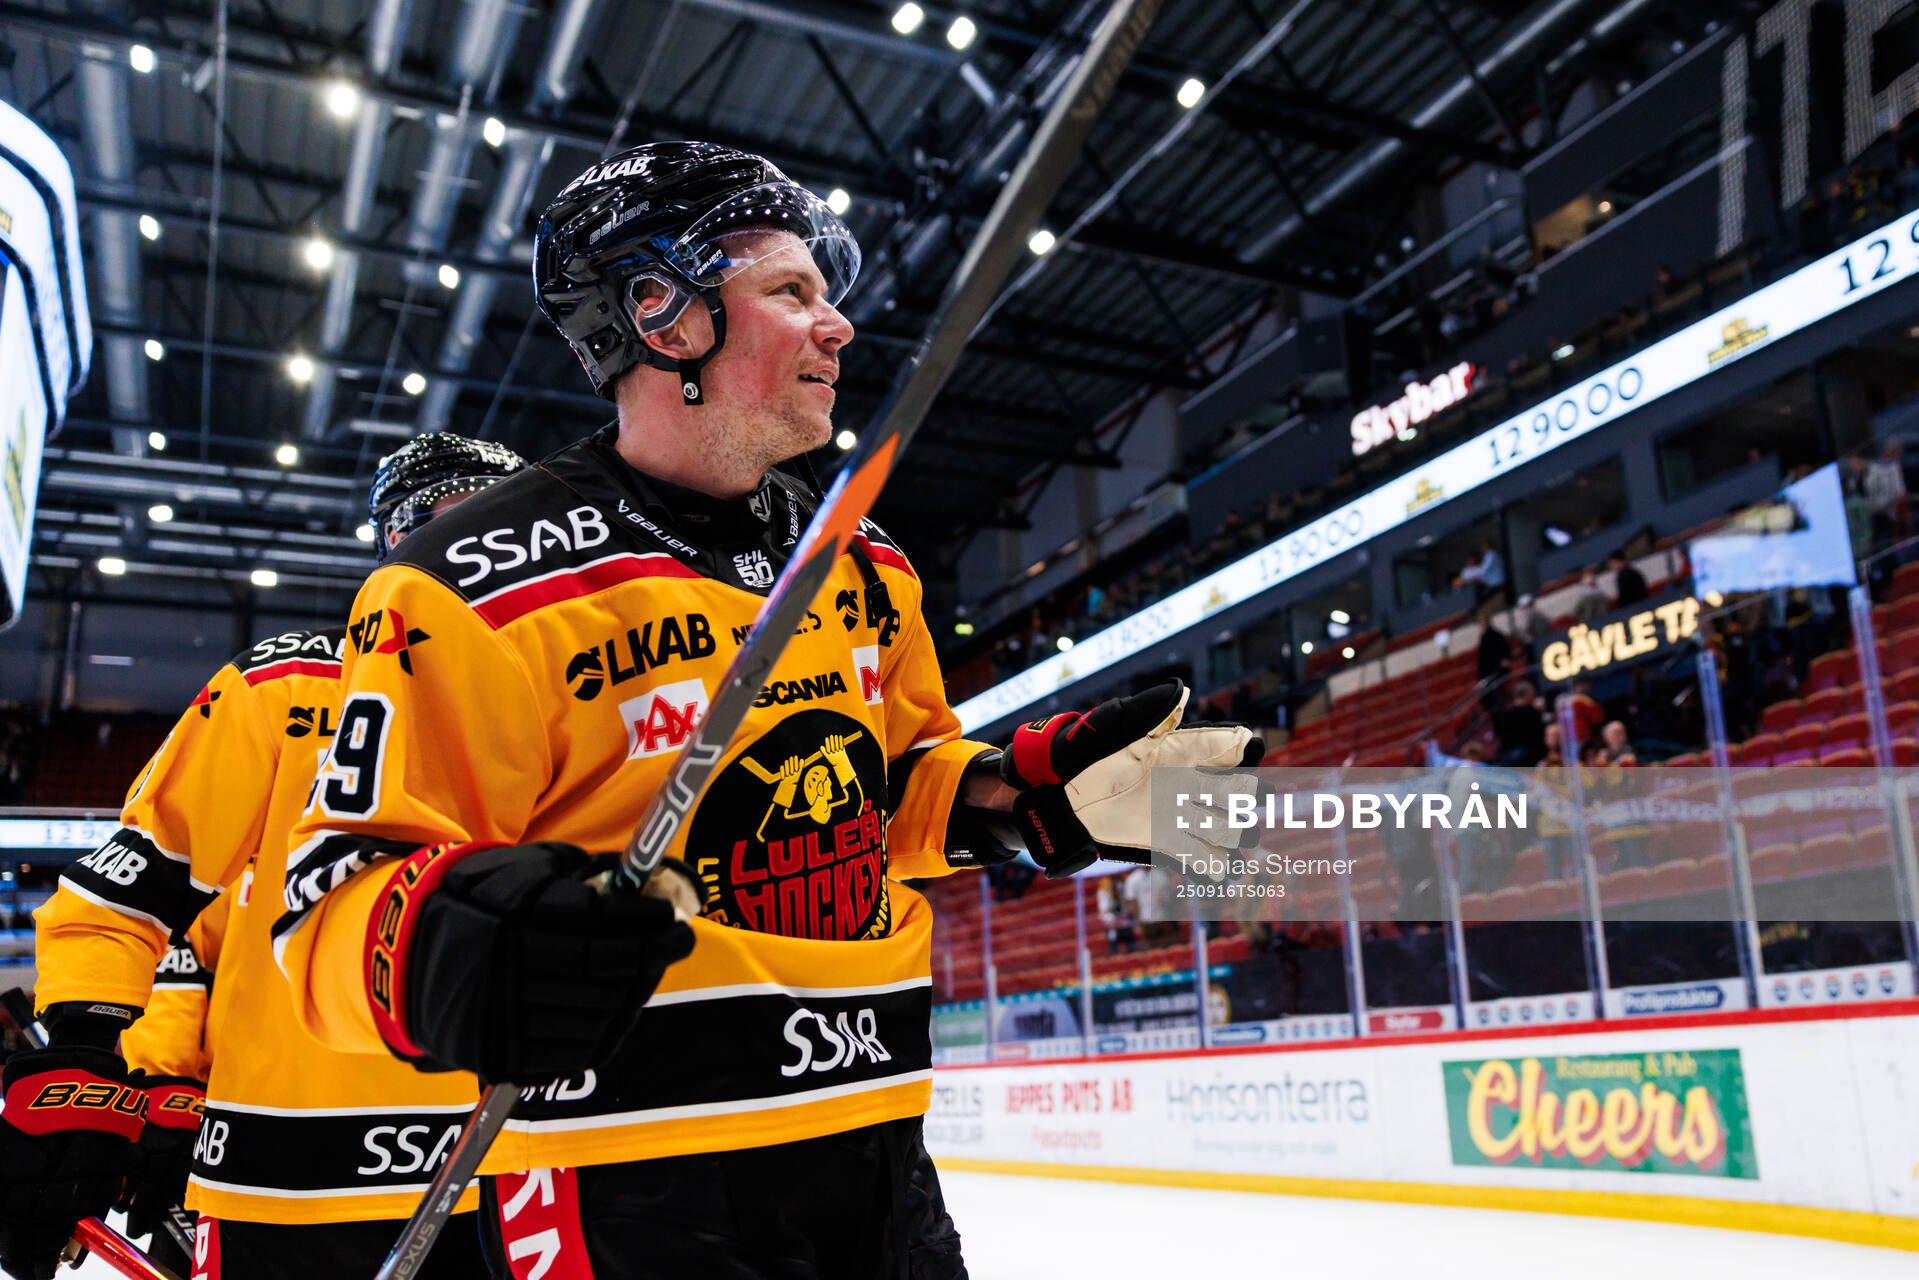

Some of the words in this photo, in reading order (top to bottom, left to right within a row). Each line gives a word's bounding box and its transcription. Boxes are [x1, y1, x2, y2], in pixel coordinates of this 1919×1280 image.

[1839, 238, 1897, 295] 12
[1351, 361, 1472, 456] Skybar
[446, 505, 610, 587] SSAB
[736, 560, 775, 588] 50
[605, 613, 717, 686] LKAB
[1542, 610, 1659, 681] GÄVLE
[751, 671, 848, 709] SCANIA
[302, 691, 396, 821] 9
[730, 799, 881, 886] LULEÅ
[733, 846, 882, 940] HOCKEY
[780, 1008, 892, 1078] SSAB
[1166, 1071, 1369, 1123] Horisonterra
[1463, 1056, 1724, 1168] Cheers
[357, 1124, 463, 1176] SSA
